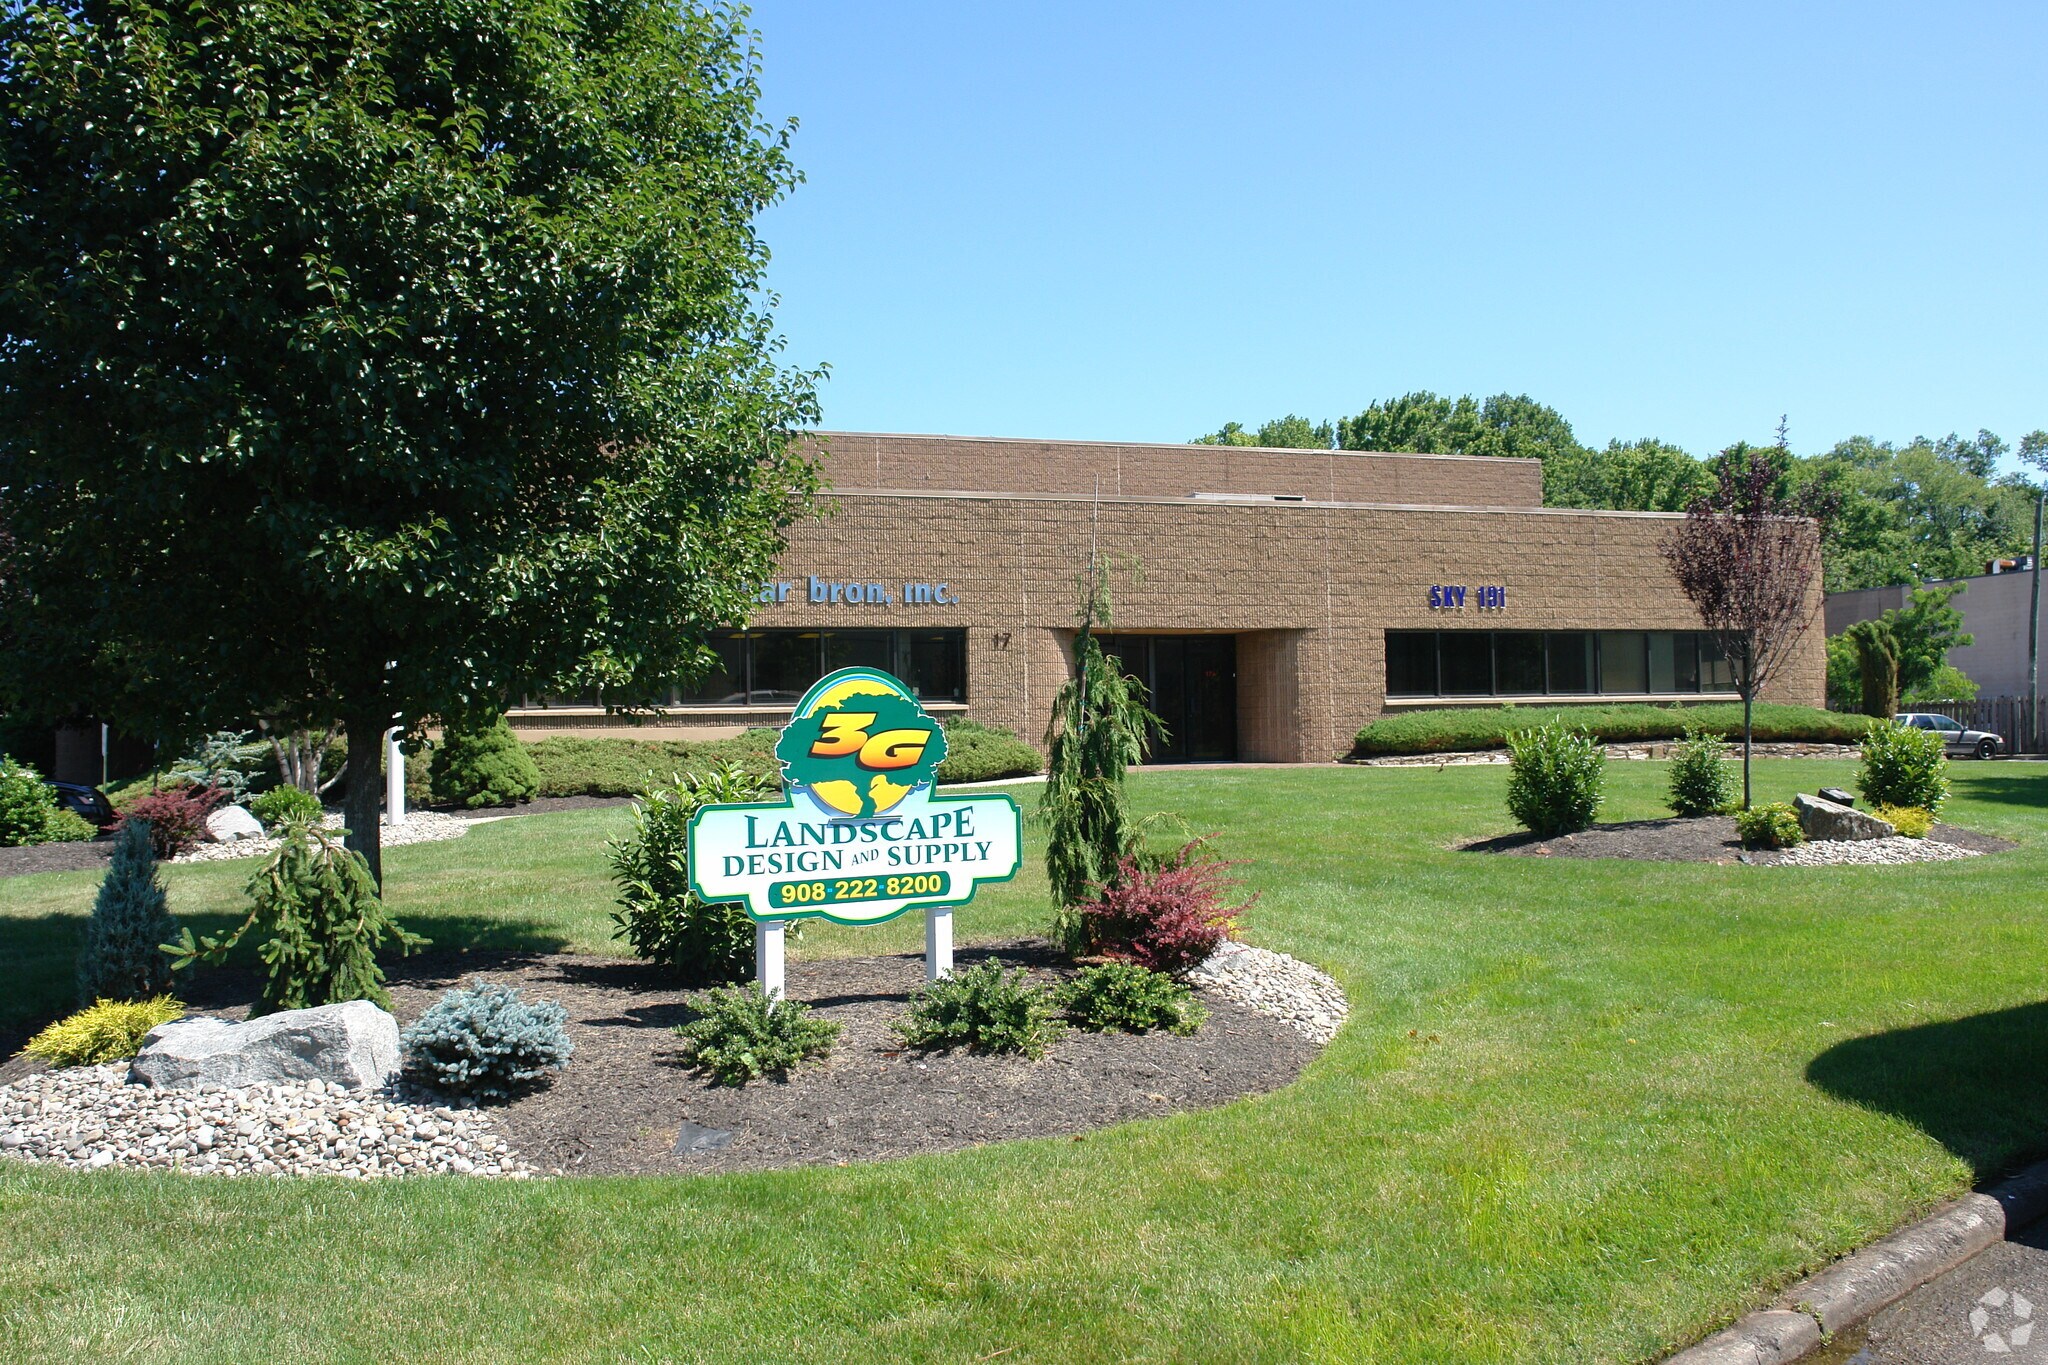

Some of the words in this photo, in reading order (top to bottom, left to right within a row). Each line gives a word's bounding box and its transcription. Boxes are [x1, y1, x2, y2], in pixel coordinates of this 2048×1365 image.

[809, 575, 892, 605] bron,
[1430, 585, 1466, 608] SKY
[1478, 585, 1506, 608] 191
[993, 633, 1011, 650] 17
[808, 711, 932, 770] 3G
[744, 805, 976, 849] LANDSCAPE
[722, 849, 843, 877] DESIGN
[851, 848, 879, 866] AND
[887, 840, 993, 867] SUPPLY
